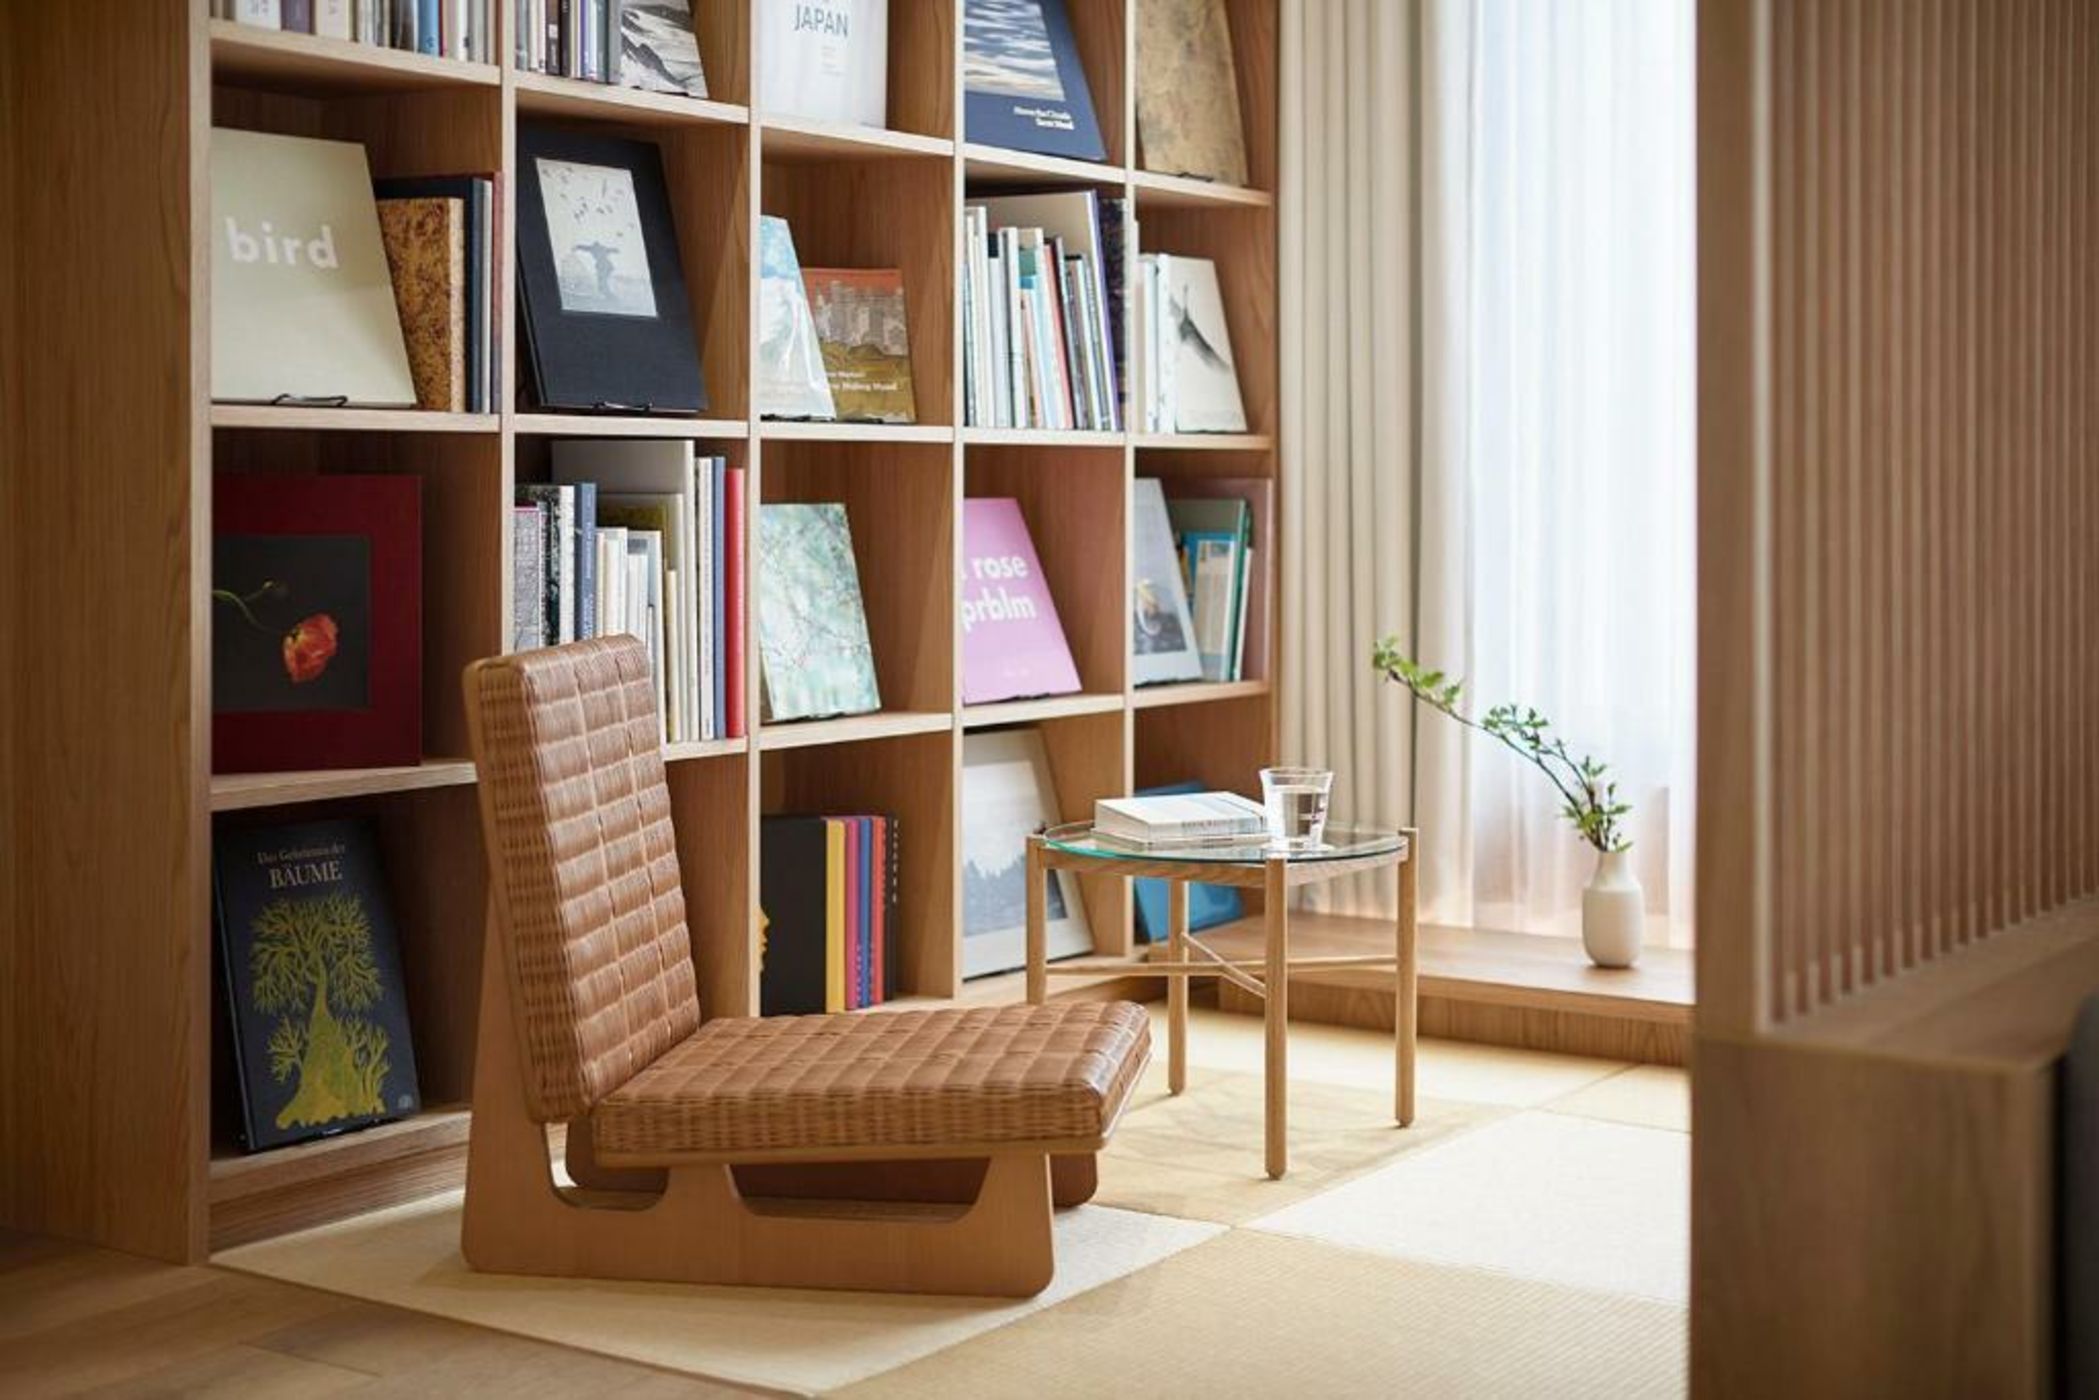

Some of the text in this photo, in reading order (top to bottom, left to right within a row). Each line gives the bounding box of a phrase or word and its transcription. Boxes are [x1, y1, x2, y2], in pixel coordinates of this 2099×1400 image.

[793, 4, 849, 38] JAPAN
[225, 216, 340, 268] bird
[971, 556, 1029, 579] rose
[960, 586, 1037, 632] prblm
[268, 860, 343, 889] BÄUME
